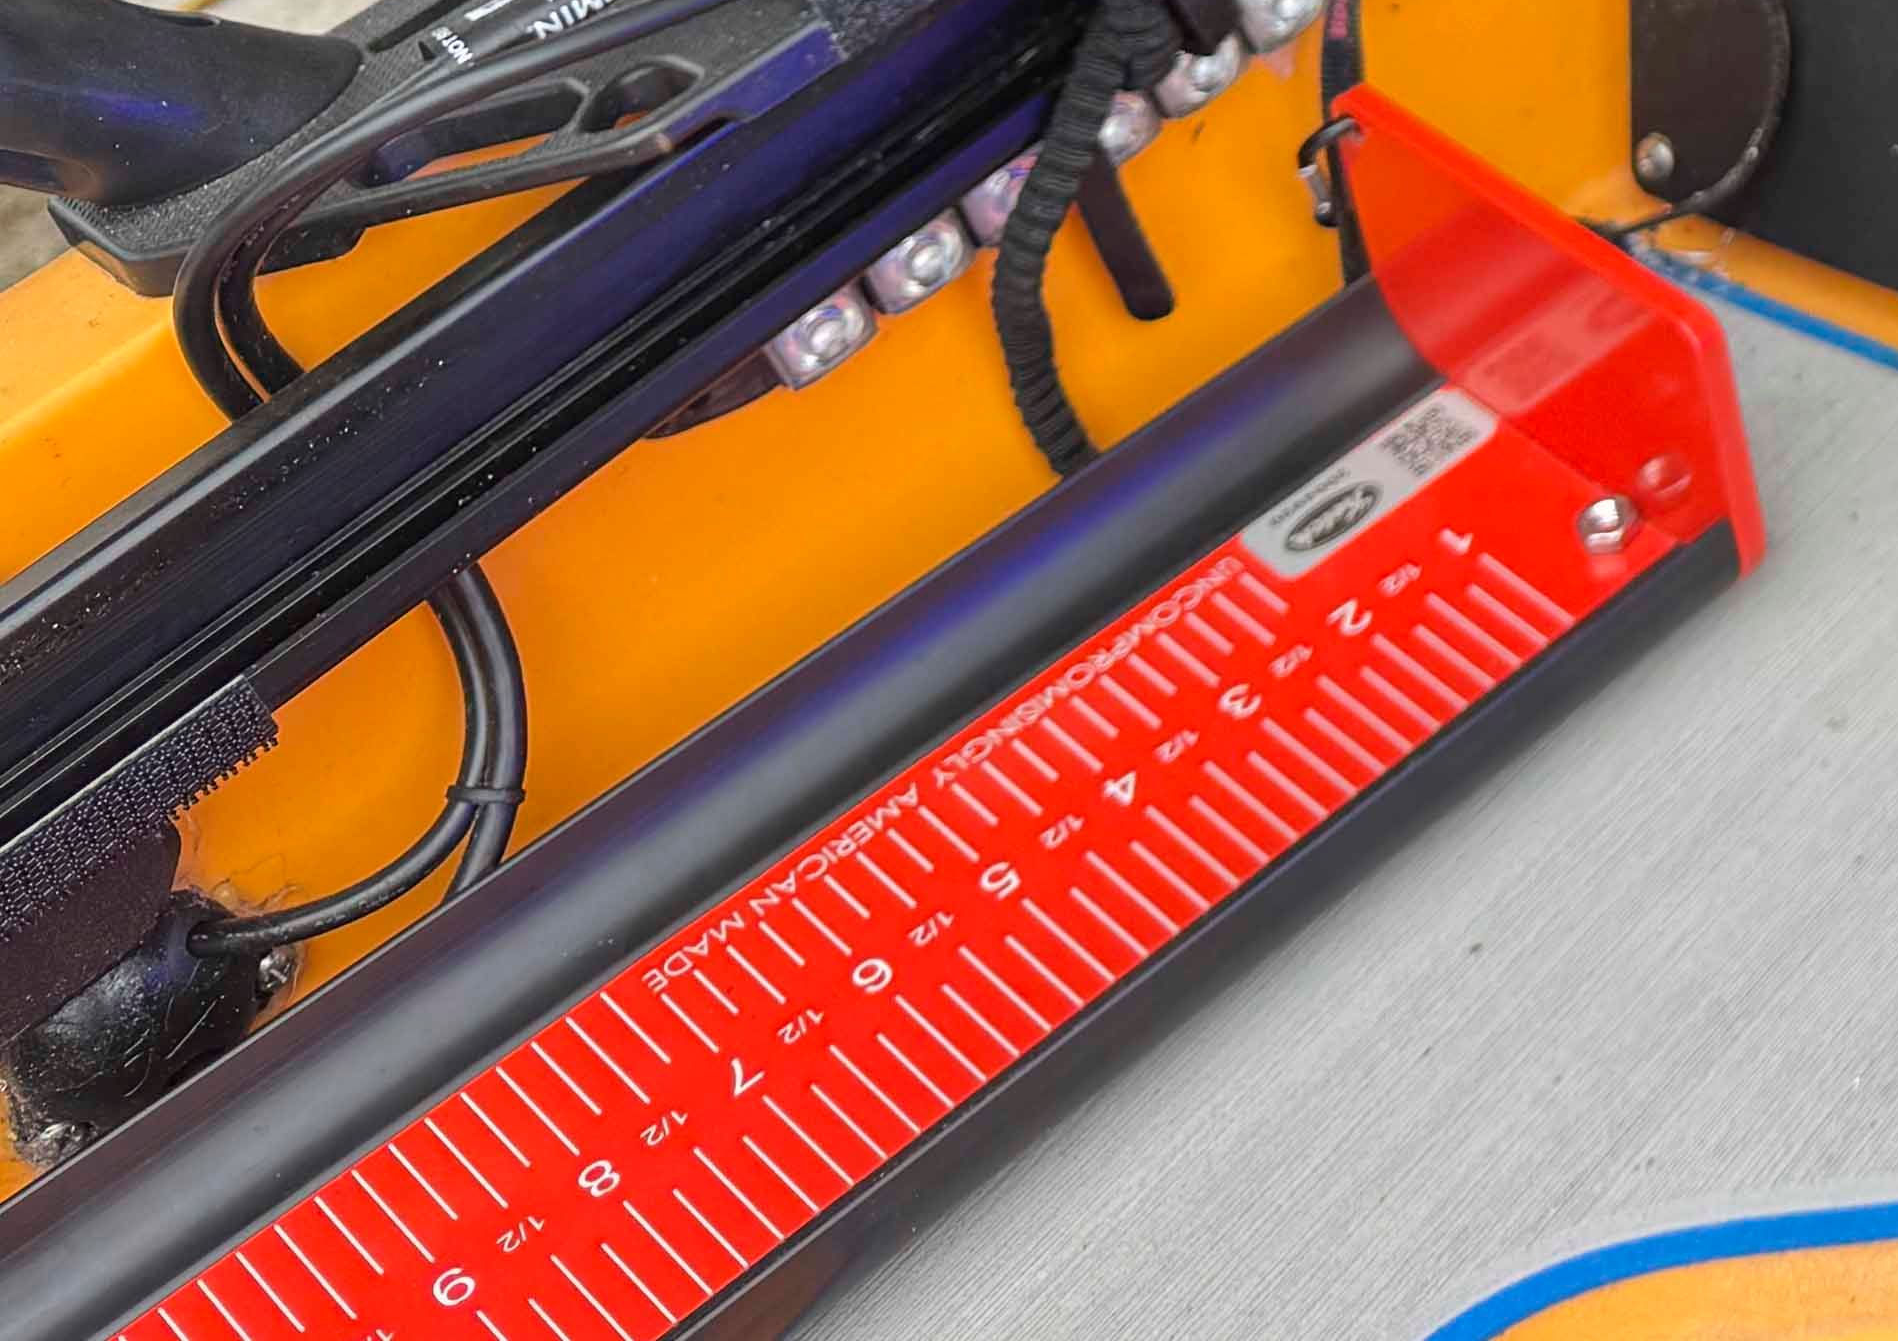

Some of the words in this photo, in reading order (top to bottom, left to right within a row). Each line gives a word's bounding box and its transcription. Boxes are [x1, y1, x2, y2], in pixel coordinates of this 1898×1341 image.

[1439, 526, 1473, 555] 1
[1328, 597, 1372, 635] 2
[931, 557, 1246, 789] UNCOMPROMISINGLY
[1219, 683, 1262, 720] 3
[1154, 729, 1200, 764] 1/2
[1103, 772, 1139, 805] 4
[757, 782, 918, 915] AMERICAN
[1040, 814, 1085, 850] 1/2
[979, 861, 1021, 901] 5
[909, 910, 954, 946] 1/2
[641, 910, 745, 992] MADE
[851, 957, 893, 994] 6
[778, 1008, 823, 1045] 1/2
[728, 1058, 764, 1097] 7
[641, 1108, 688, 1146] 1/2
[577, 1159, 621, 1198] 8
[496, 1216, 545, 1253] 1/2
[432, 1267, 476, 1306] 9
